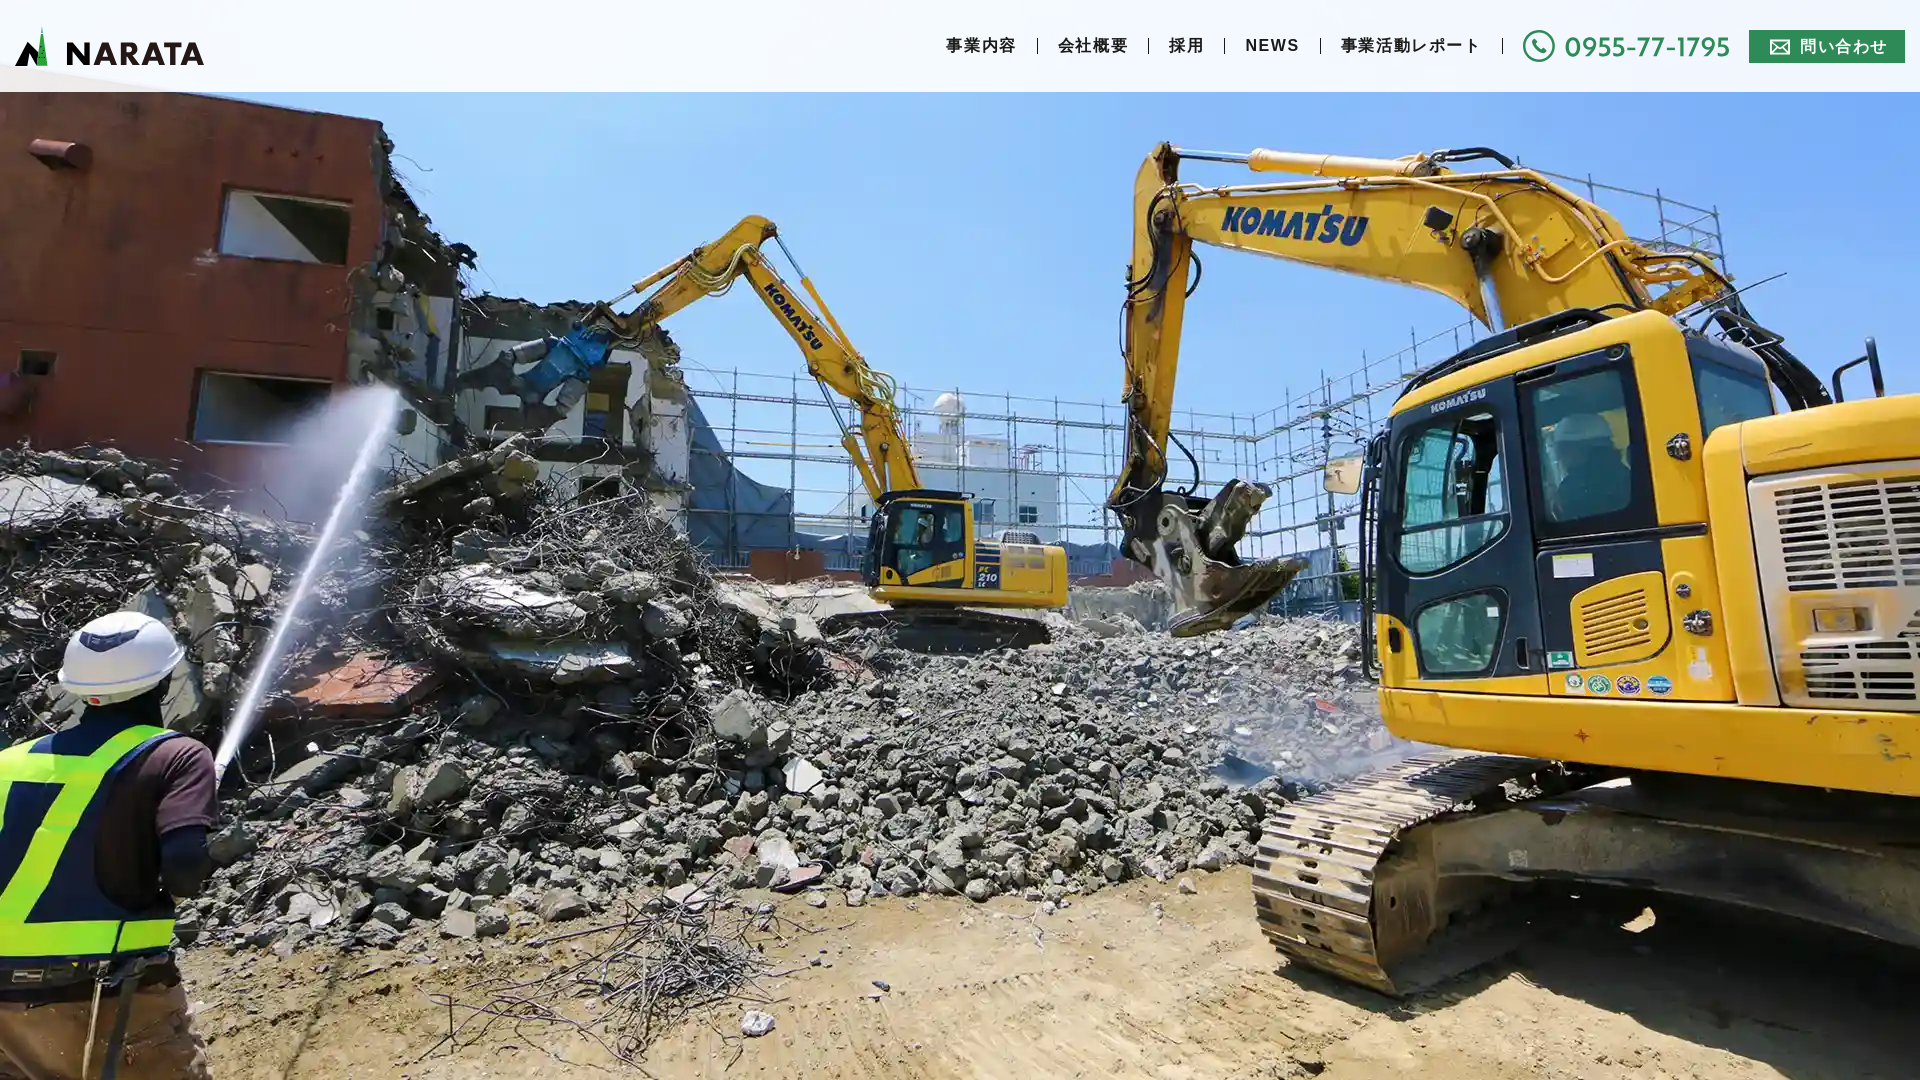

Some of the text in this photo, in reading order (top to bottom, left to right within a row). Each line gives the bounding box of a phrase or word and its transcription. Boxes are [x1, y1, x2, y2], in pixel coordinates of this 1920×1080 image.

[1221, 204, 1370, 247] KOMATSU
[763, 282, 824, 350] KOMATSU
[1430, 387, 1487, 414] KOMATSU
[978, 573, 998, 582] 210
